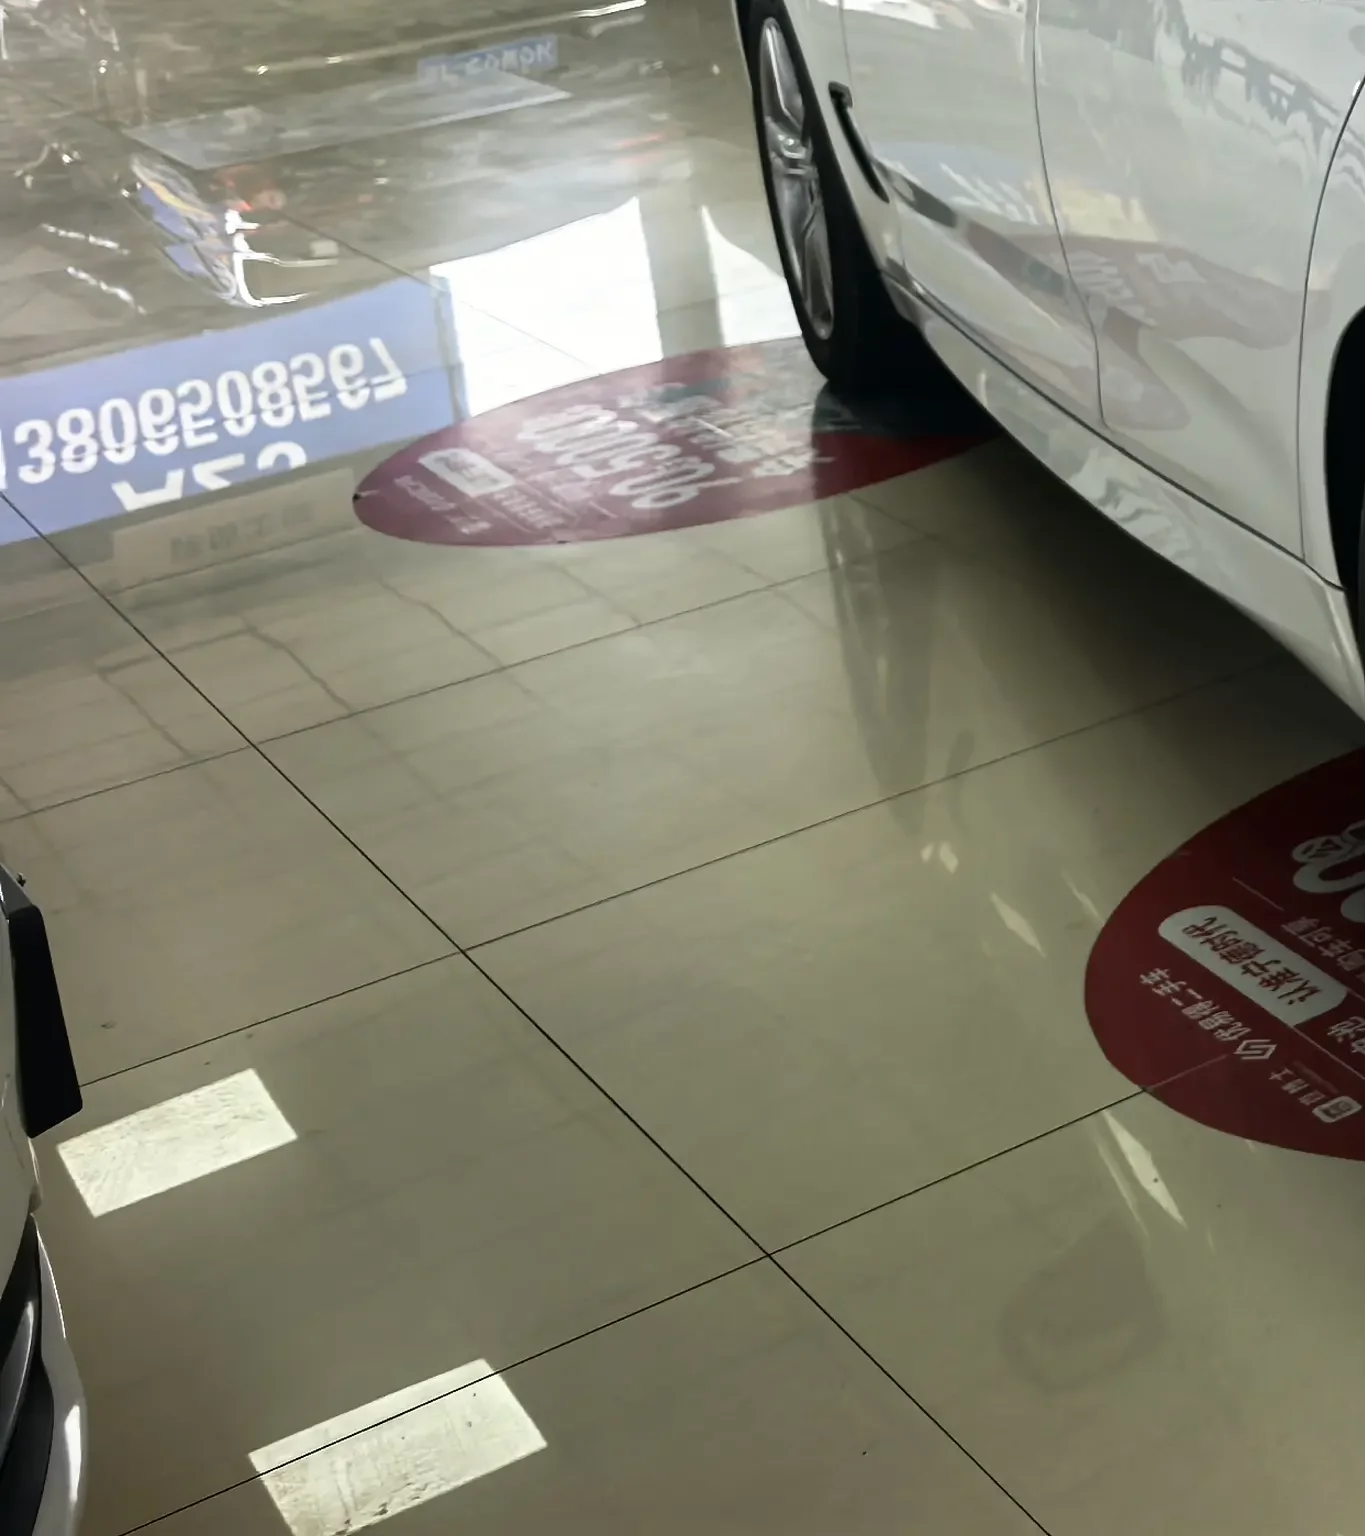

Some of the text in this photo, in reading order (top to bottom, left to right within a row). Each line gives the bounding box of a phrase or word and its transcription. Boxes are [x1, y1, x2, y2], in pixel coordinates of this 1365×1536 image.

[1181, 915, 1321, 1005] 认准宁德时代
